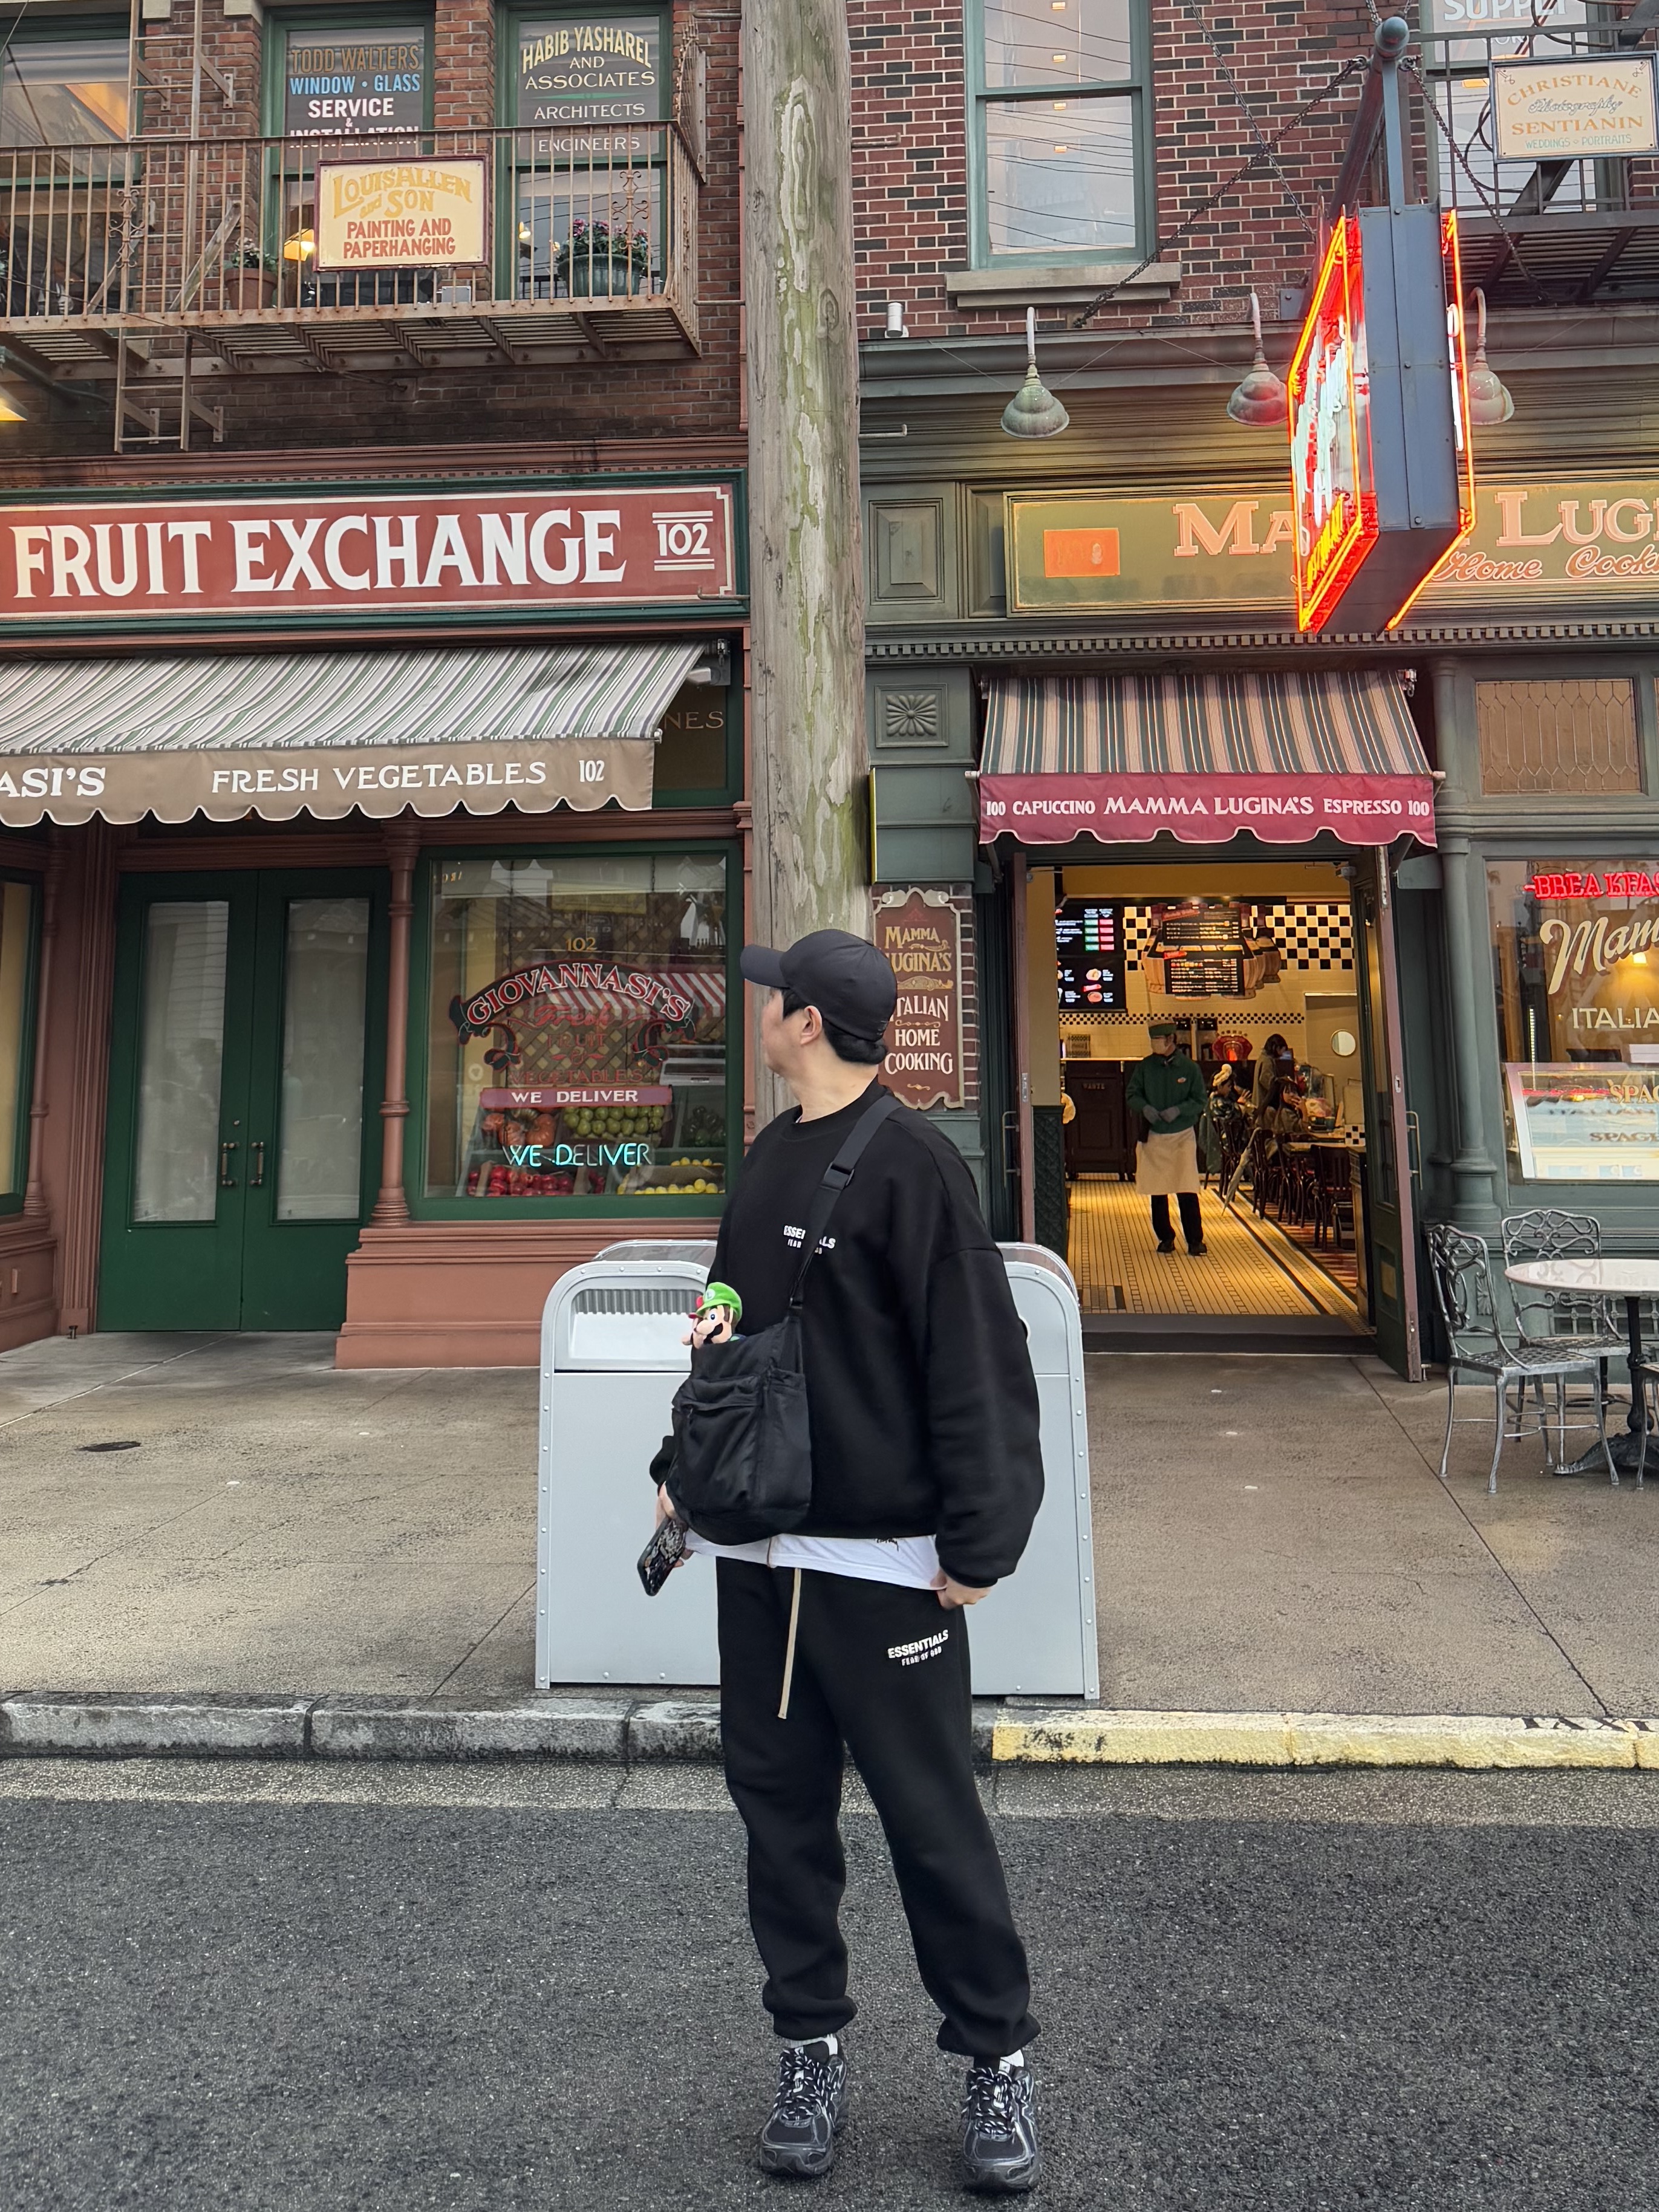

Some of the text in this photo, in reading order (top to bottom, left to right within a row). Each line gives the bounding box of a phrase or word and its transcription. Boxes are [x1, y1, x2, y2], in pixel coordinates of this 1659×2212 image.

[290, 45, 419, 73] TODD WALTERS
[523, 26, 651, 74] HABIB YASHAREL
[569, 56, 605, 69] AND
[290, 73, 420, 95] WINDOW GLASS
[525, 71, 656, 90] ASSOCIATES
[1507, 75, 1642, 106] CHRISTIANE
[308, 97, 394, 118] SERVICE
[534, 103, 645, 120] ARCHITECTS
[1528, 94, 1623, 116] Photography
[345, 118, 353, 128] &
[1512, 115, 1644, 135] SENTIANIN
[539, 137, 640, 152] ENGINEERS
[1525, 134, 1632, 149] WEDDINGS PORTRAITS
[384, 189, 435, 218] SON
[347, 218, 451, 239] PAINTING AND
[343, 237, 456, 259] PAPERHANGING
[1496, 490, 1659, 547] LUG
[8, 507, 711, 598] FRUIT EXCHANGE 102
[1432, 551, 1543, 582] Home
[0, 760, 605, 798] ASI'S FRESH VEGETABLES 102
[986, 796, 1430, 816] 100 CAPUCCINO MAMMA LUGINA'S ESPRESSO 100
[565, 937, 597, 952] 102
[885, 926, 940, 949] MAMMA
[885, 952, 952, 972] UGINA'S
[467, 963, 691, 1024] GIOVANNASI'S
[534, 1001, 612, 1027] Fresh
[890, 995, 948, 1022] TALIAN
[547, 1033, 607, 1048] FRUIT
[895, 1029, 940, 1047] HOME
[884, 1052, 953, 1075] COOKING
[509, 1069, 644, 1085] VEGETABLES
[511, 1090, 638, 1104] WE DELIVER
[502, 1143, 652, 1166] WE DELIVER
[888, 1629, 948, 1658] ESSENTIALS
